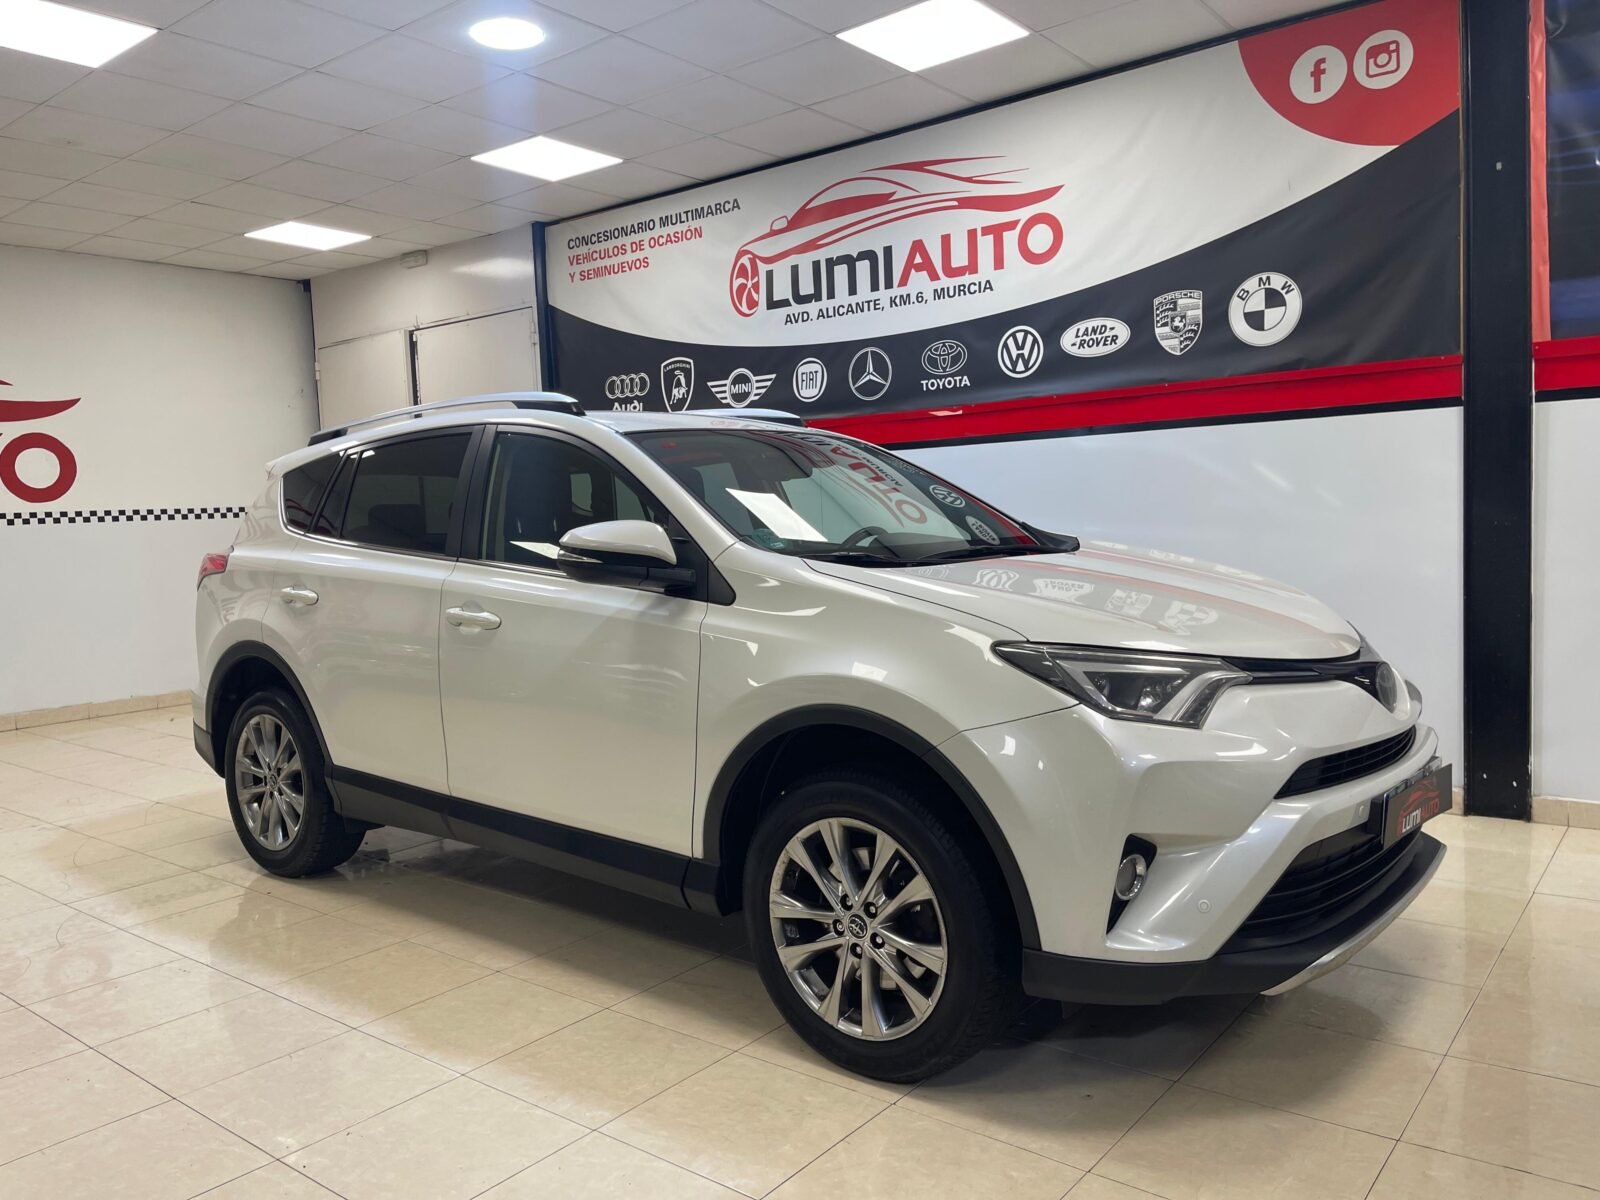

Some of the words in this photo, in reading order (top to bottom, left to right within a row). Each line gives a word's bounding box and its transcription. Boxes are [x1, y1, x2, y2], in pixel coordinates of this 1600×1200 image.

[567, 219, 656, 249] CONCESIONARIO
[659, 198, 741, 228] MULTIMARCA
[568, 244, 627, 266] VEHÍCULOS
[630, 240, 645, 252] DE
[649, 225, 703, 248] OCASIÓN
[568, 272, 577, 283] Y
[579, 256, 650, 281] SEMINUEVOS
[784, 309, 813, 326] AVD.
[816, 297, 885, 320] ALICANTE,
[889, 288, 928, 308] KM.6,
[933, 279, 994, 301] MURCIA
[1155, 291, 1201, 306] PORSCHE
[664, 363, 691, 372] LAMBORGHINI
[801, 370, 819, 384] FIAT
[921, 376, 970, 391] TOYOTA
[730, 383, 751, 394] MINI
[612, 400, 643, 412] Audi
[0, 432, 77, 503] O
